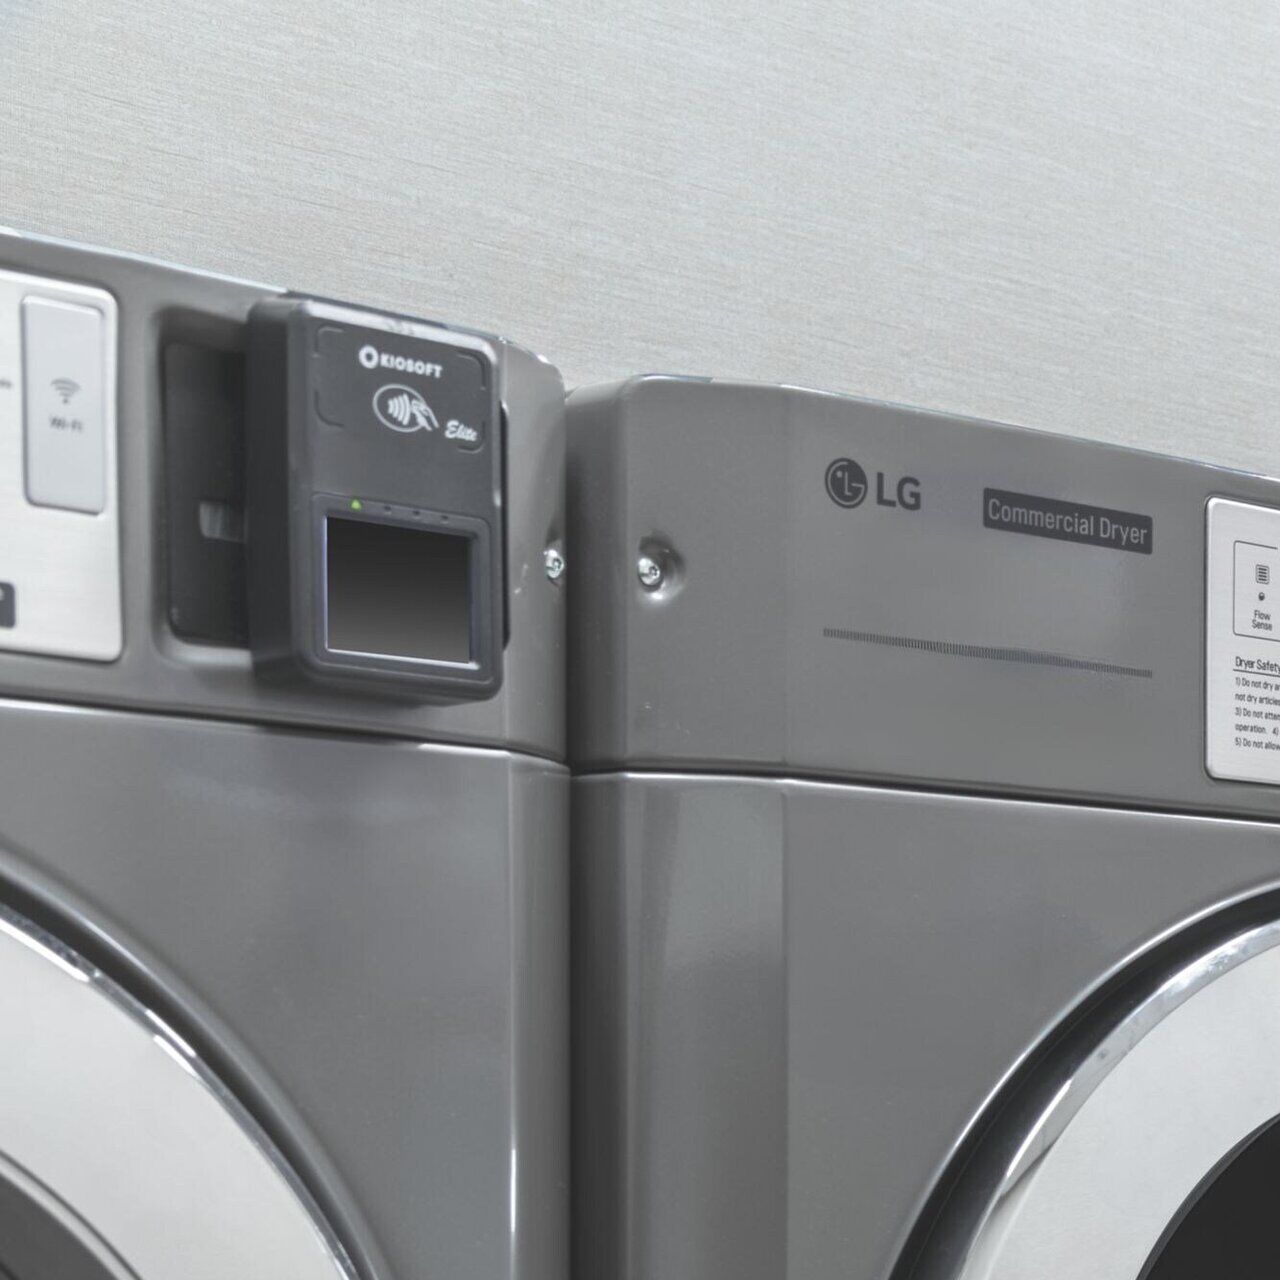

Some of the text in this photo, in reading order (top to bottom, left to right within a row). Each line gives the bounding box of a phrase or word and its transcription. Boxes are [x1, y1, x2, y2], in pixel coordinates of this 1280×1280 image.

[380, 353, 442, 378] KIOSOFT
[445, 419, 477, 441] Elite
[876, 471, 921, 511] LG
[988, 499, 1147, 546] Commercial Dryer
[1252, 619, 1273, 632] Sense
[1253, 609, 1271, 622] Flow
[1235, 656, 1254, 669] Dryer
